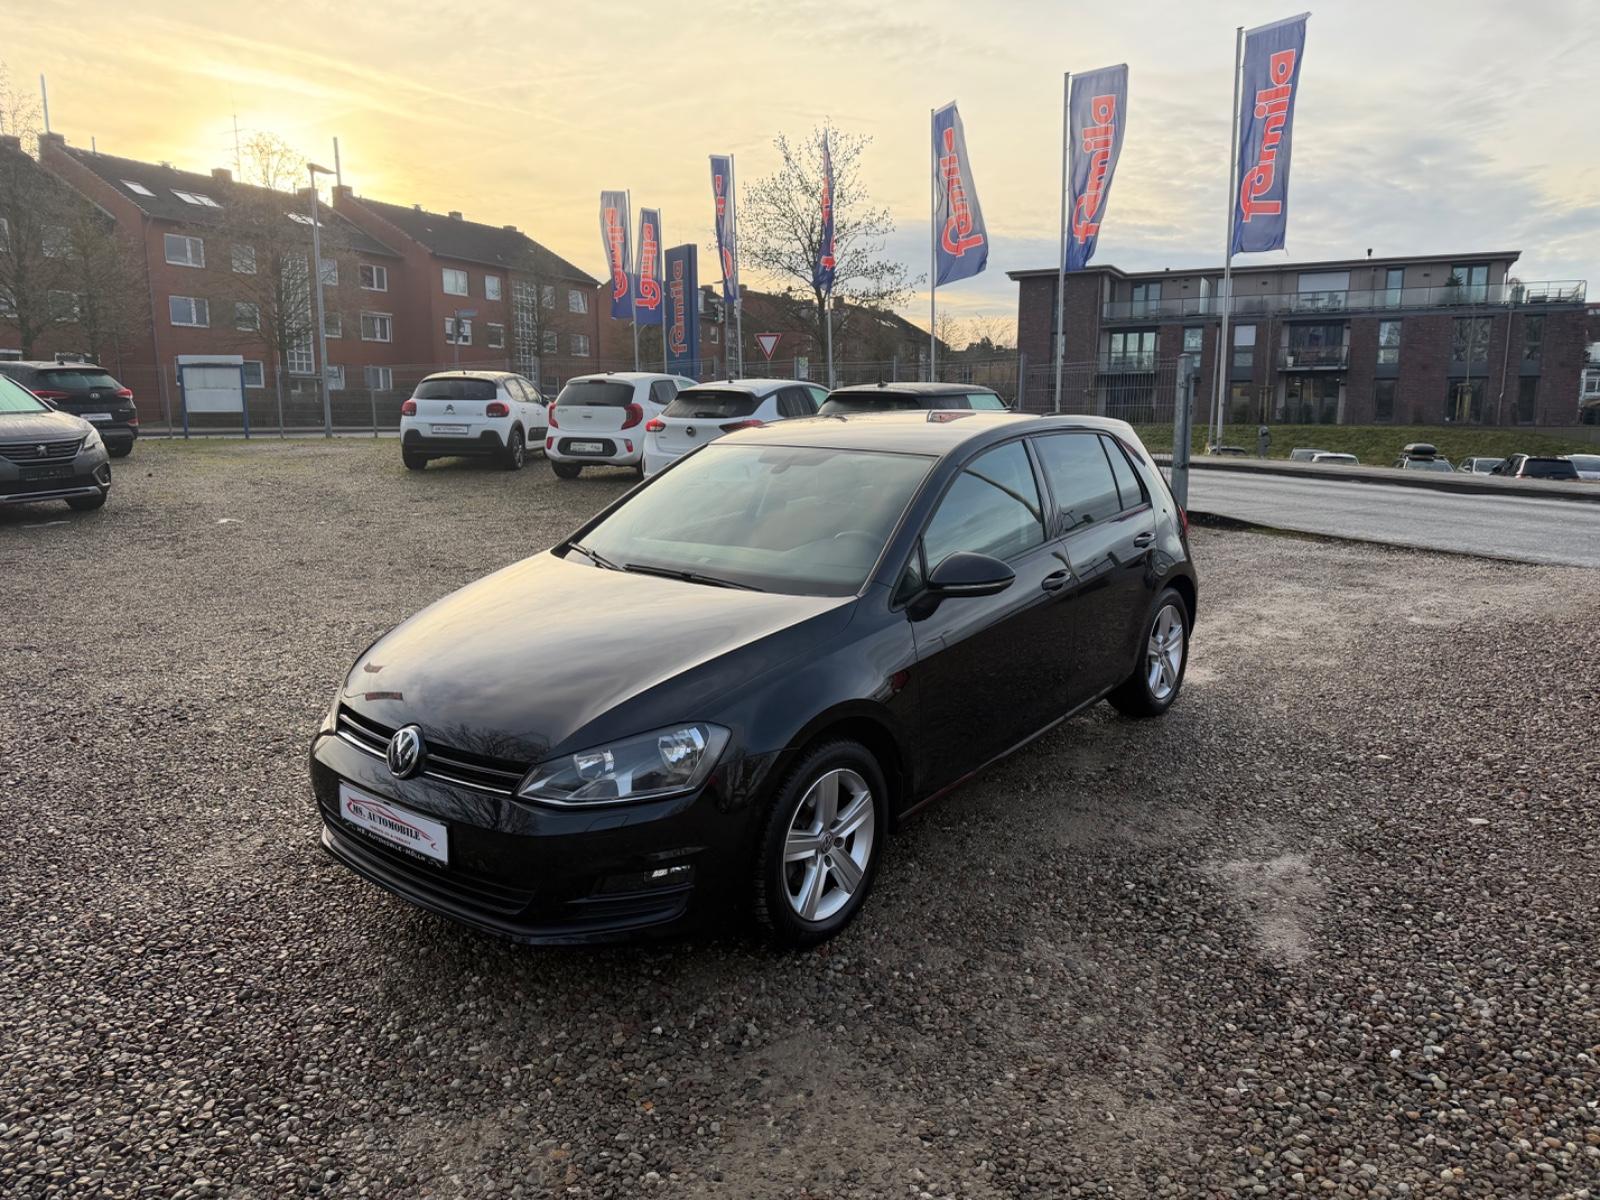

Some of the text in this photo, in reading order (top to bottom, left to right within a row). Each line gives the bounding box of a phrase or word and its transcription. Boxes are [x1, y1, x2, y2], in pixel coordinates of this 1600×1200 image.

[1072, 94, 1117, 245] famila
[1241, 48, 1296, 223] famila
[668, 259, 688, 358] famila
[367, 811, 421, 841] AUTOMOBILE
